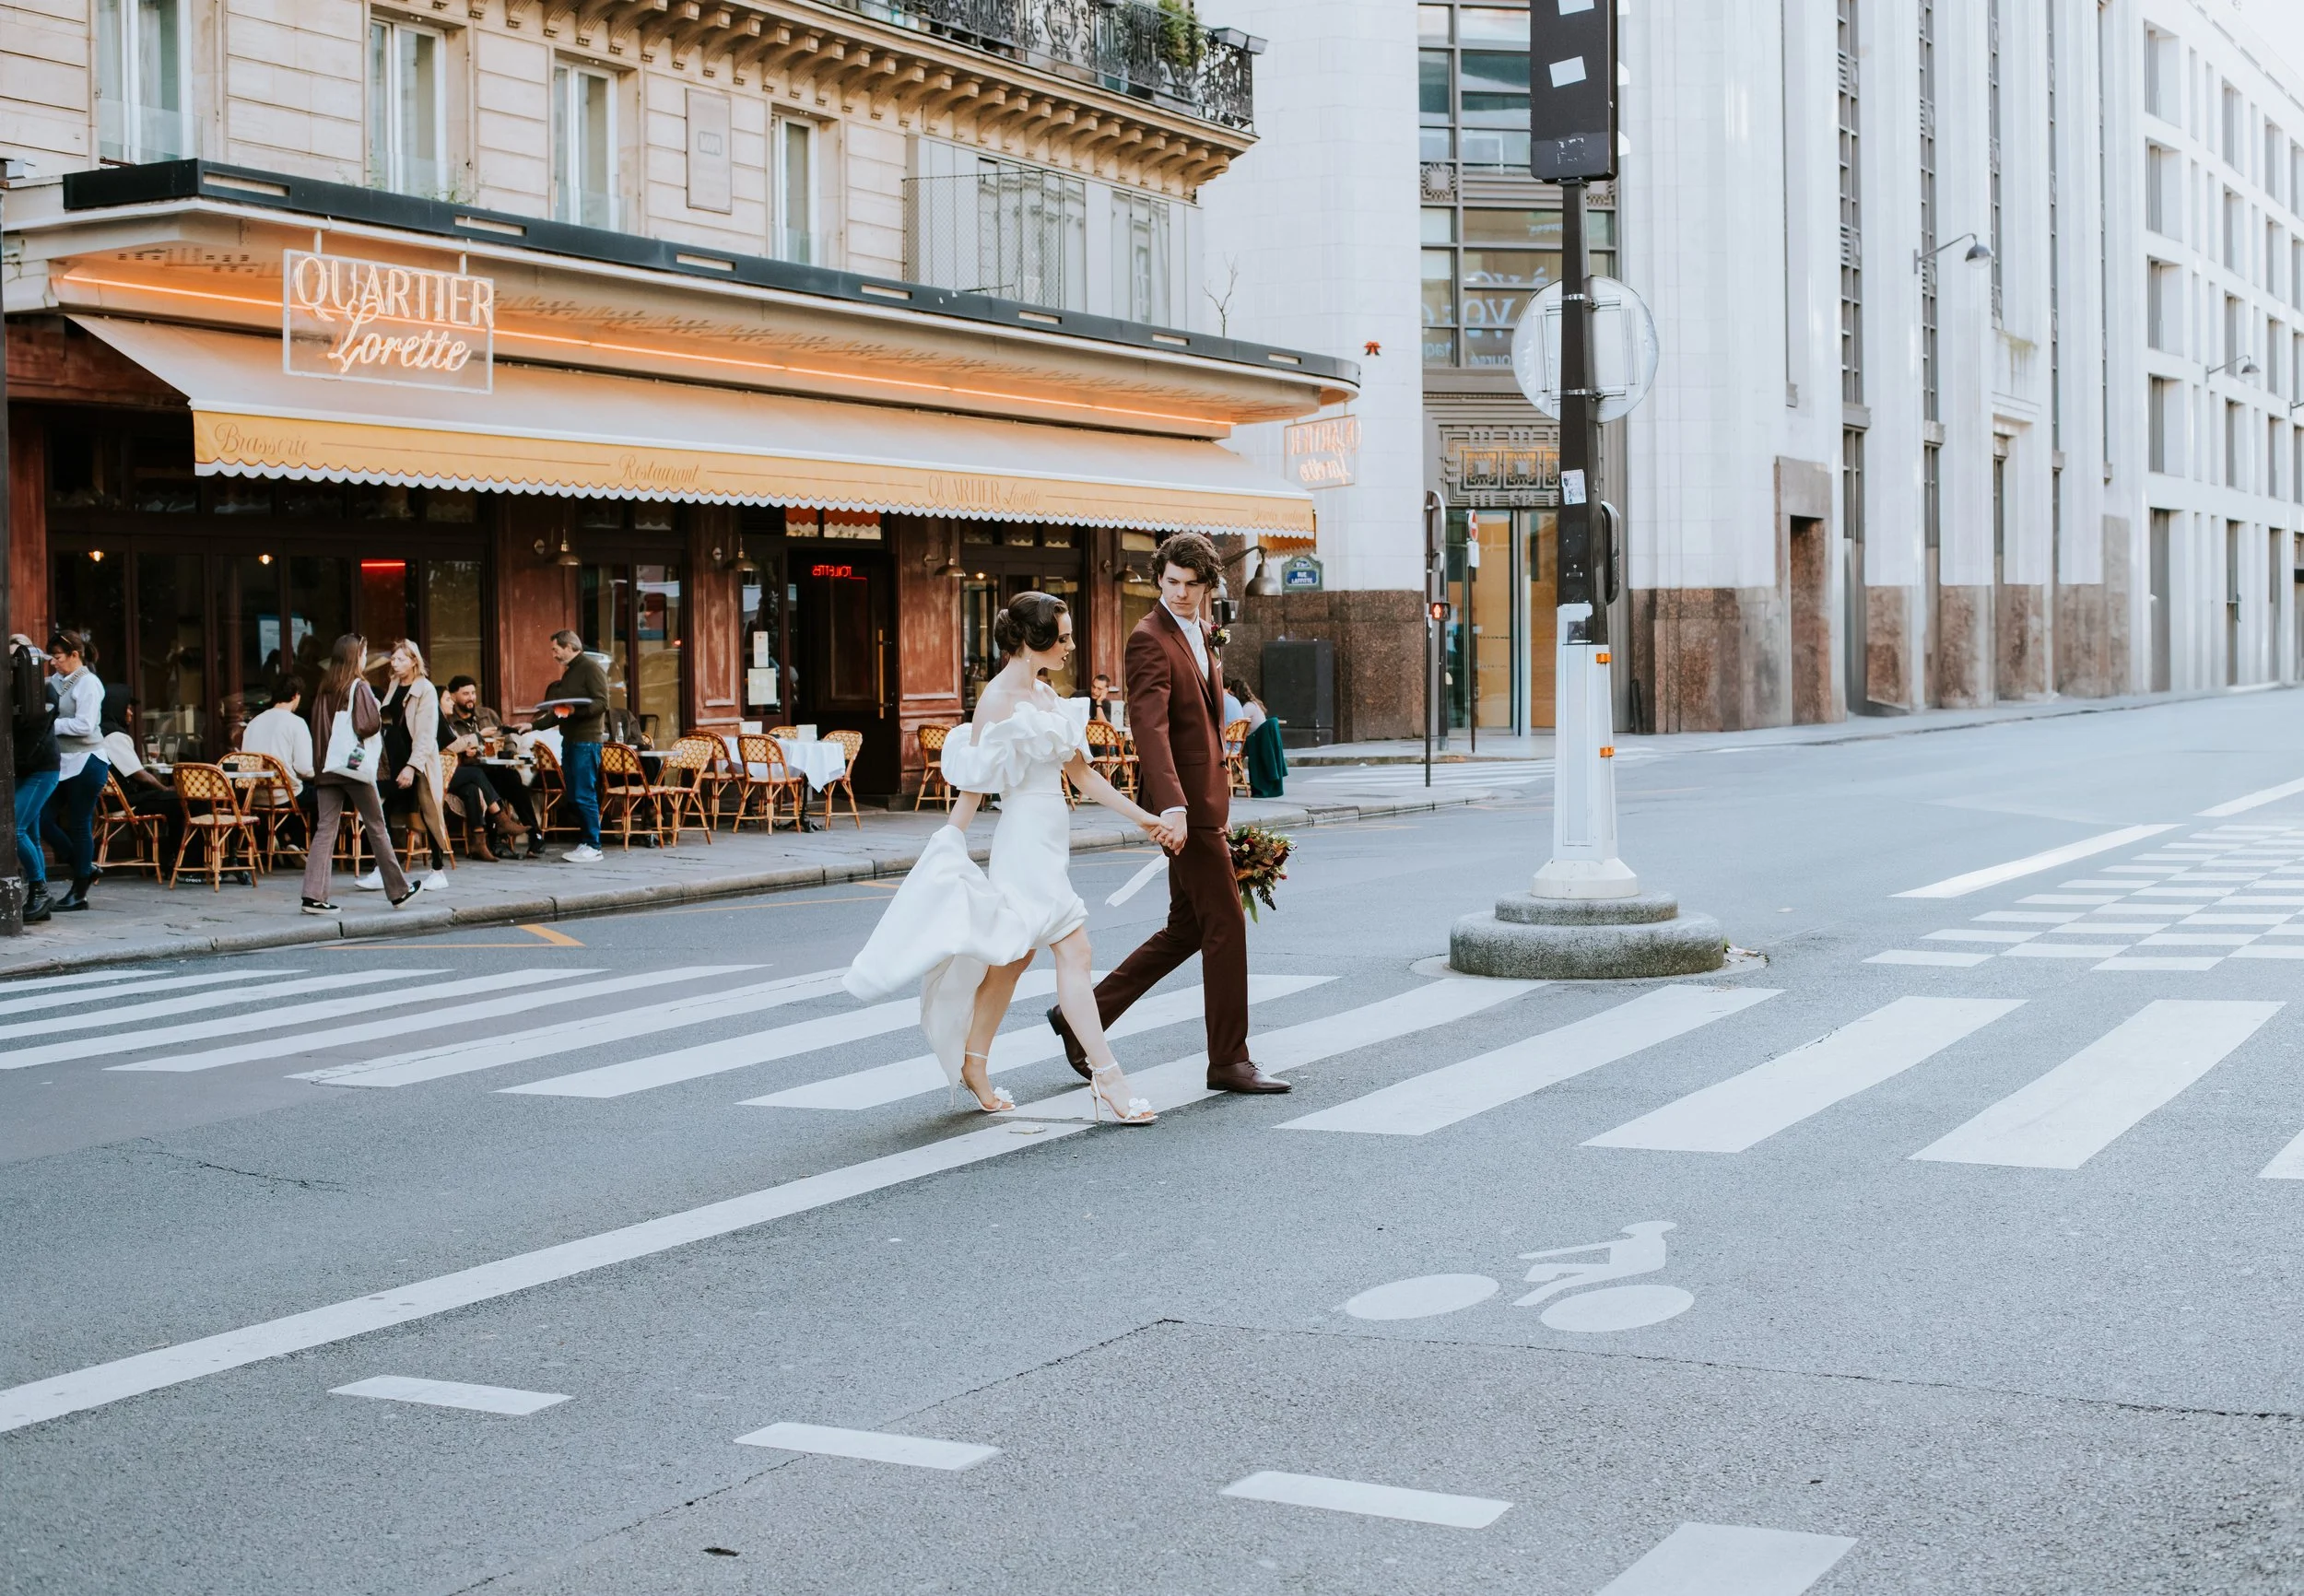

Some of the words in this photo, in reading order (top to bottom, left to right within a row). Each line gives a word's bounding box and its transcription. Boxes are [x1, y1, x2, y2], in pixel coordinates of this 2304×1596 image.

[296, 257, 495, 327] QUARTIER
[327, 300, 472, 373] Lorette
[214, 422, 310, 457] Brasserie
[618, 453, 699, 483] Restaurant
[928, 474, 1001, 506] QUARTIER
